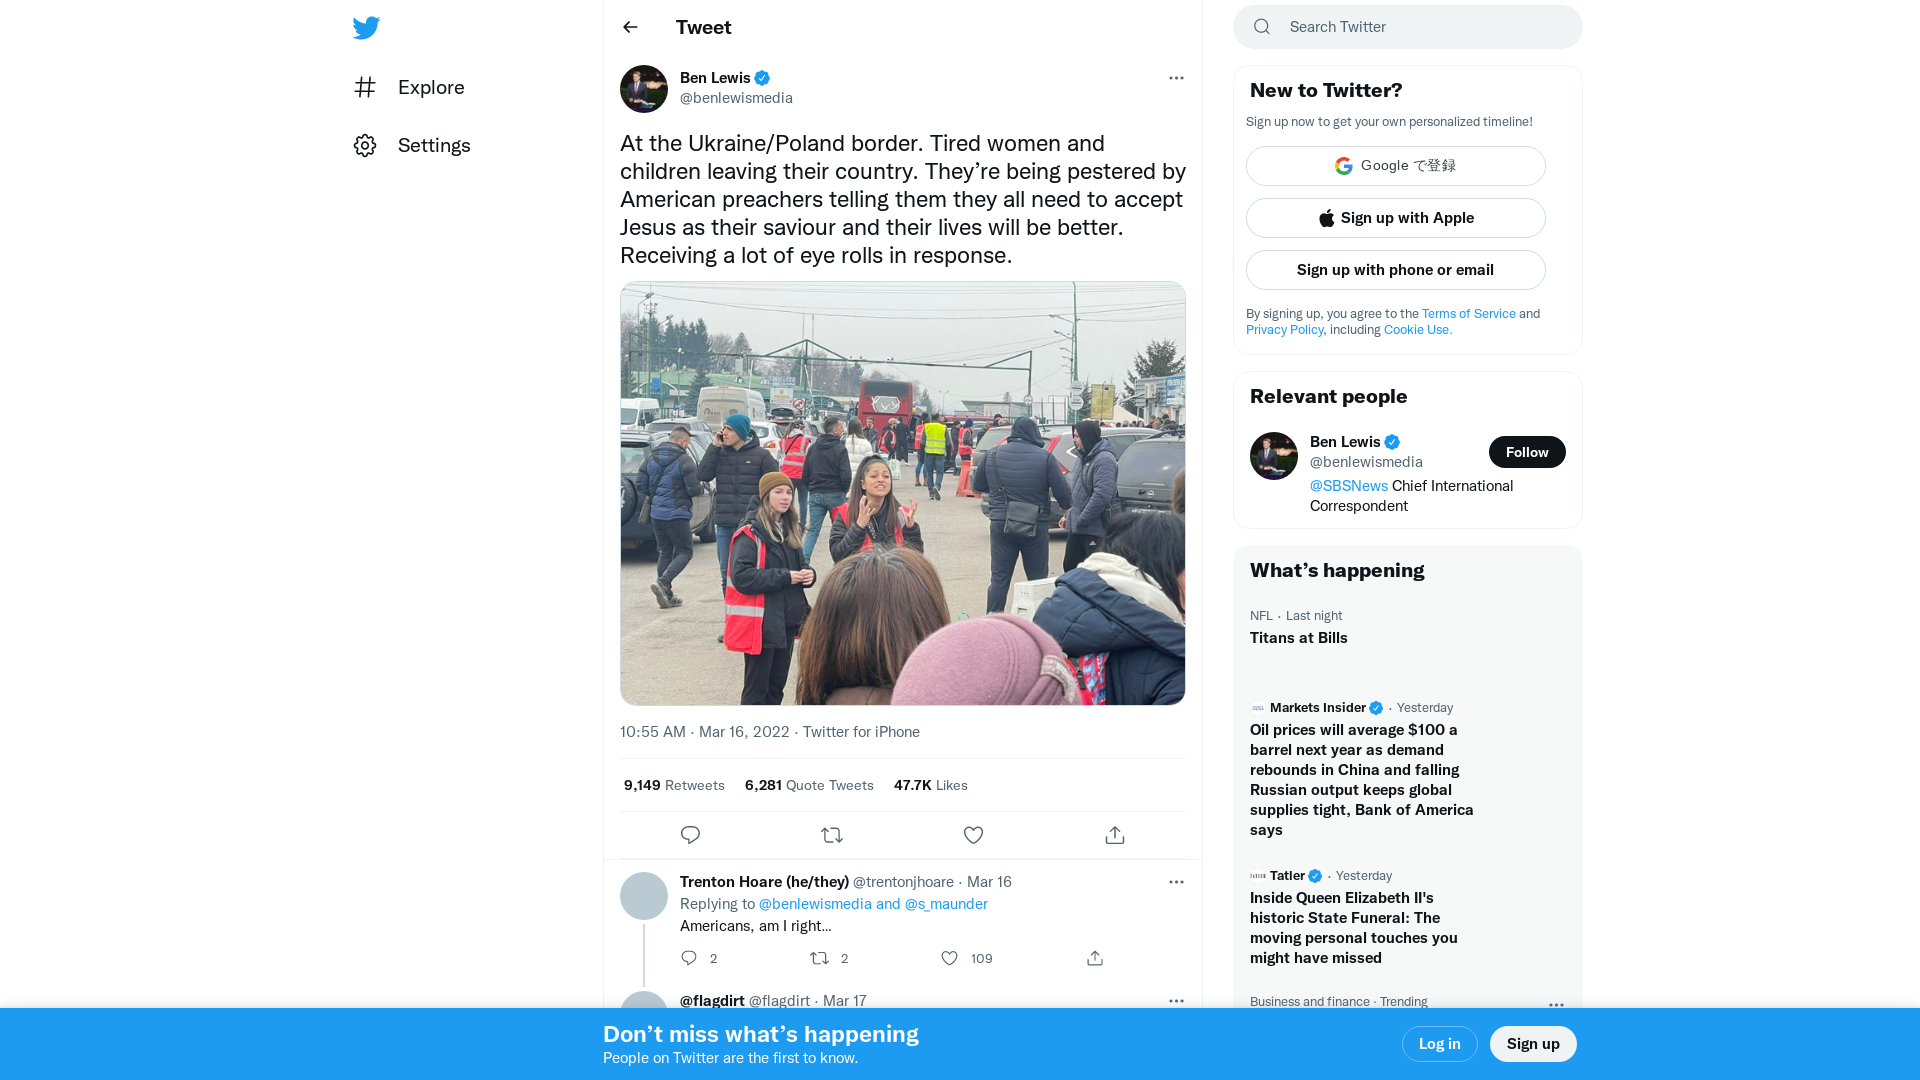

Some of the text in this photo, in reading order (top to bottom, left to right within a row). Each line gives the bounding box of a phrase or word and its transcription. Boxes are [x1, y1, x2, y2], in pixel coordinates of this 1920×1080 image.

[676, 20, 732, 34] Tweet
[1290, 21, 1386, 32] Search Twitter
[681, 71, 750, 83] Ben Lewis
[399, 80, 464, 98] Explore
[1251, 82, 1402, 97] New to Twitter?
[680, 92, 792, 105] @benlewismedia
[1246, 116, 1271, 129] Sign
[1275, 119, 1288, 129] up
[1318, 117, 1330, 126] to
[1333, 117, 1351, 129] get
[1355, 119, 1379, 129] your
[1410, 116, 1480, 129] personalized
[1483, 116, 1532, 126] timeline!
[398, 137, 470, 156] Settings
[620, 134, 1104, 154] At the Ukraine/Poland border. Tired women and
[1361, 159, 1455, 173] Google で登録
[620, 190, 1183, 211] American preachers telling them they all need to accept
[1341, 211, 1474, 226] Sign up with Apple
[1247, 308, 1540, 321] By signing up, you agree to the Terms of Service and
[1247, 324, 1452, 337] Privacy Policy, including Cookie Use.
[1251, 389, 1407, 407] Relevant people
[1311, 435, 1380, 447] Ben Lewis
[1507, 447, 1549, 457] Follow
[1310, 456, 1422, 469] @benlewismedia
[1310, 480, 1513, 492] @SBSNews Chief International
[1310, 500, 1408, 514] Correspondent
[1250, 562, 1425, 581] What’s happening
[1251, 610, 1342, 623] NFL Last night
[1250, 631, 1347, 643] Titans at Bills
[1271, 703, 1319, 712] Markets
[1324, 702, 1366, 712] Insider
[1397, 703, 1453, 715] Yesterday
[621, 726, 920, 739] 10:55 AM Mar 16, 2022 Twitter for iPhone
[1250, 722, 1457, 738] Oil prices will average $100 a
[624, 780, 724, 792] 9,149 Retweets
[745, 780, 873, 792] 6,281 Quote Tweets
[894, 780, 967, 790] 47.7K Likes
[1251, 783, 1451, 798] Russian output keeps global
[1250, 803, 1473, 818] supplies tight, Bank of America
[1250, 827, 1282, 838] says
[1270, 871, 1305, 880] Tatler
[1336, 871, 1392, 883] Yesterday
[680, 875, 1011, 890] Trenton Hoare (he/they) @trentonjhoare Mar 16
[681, 898, 988, 912] Replying to @benlewismedia and @s_maunder
[1251, 891, 1433, 906] Inside Queen Elizabeth II's
[710, 954, 717, 963] 2
[841, 954, 848, 963] 2
[972, 954, 992, 963] 109
[1251, 951, 1381, 966] might have missed
[680, 994, 867, 1007] @flagdirt @flagdirt Mar 17
[1251, 996, 1428, 1007] Business and finance Trending
[604, 1024, 919, 1046] Don’t miss what’s happening
[1420, 1037, 1460, 1052] Log in
[1507, 1037, 1560, 1052] Sign up
